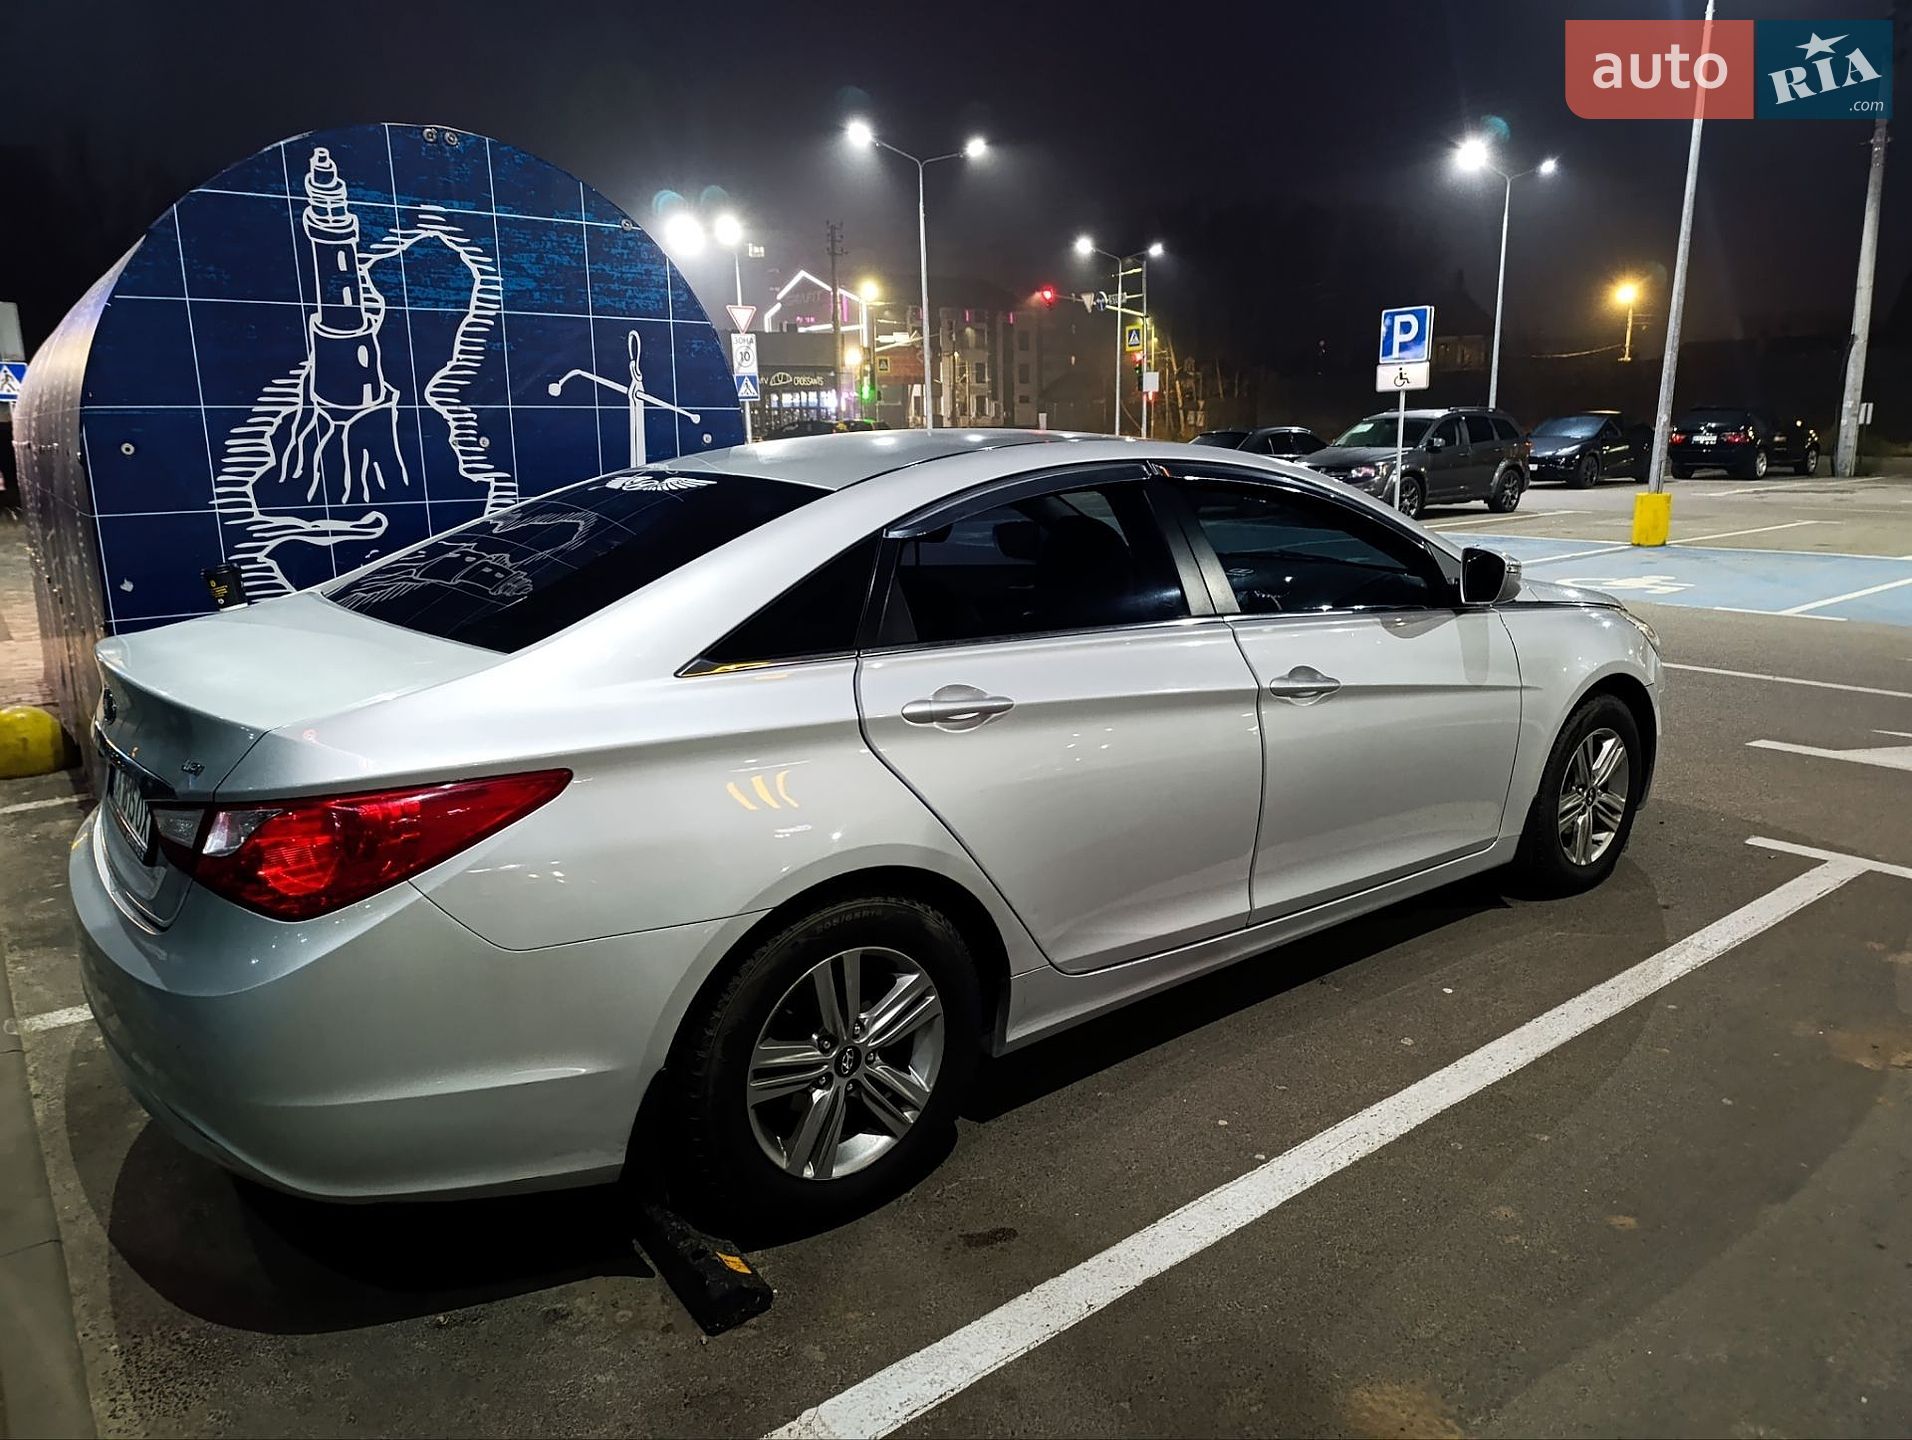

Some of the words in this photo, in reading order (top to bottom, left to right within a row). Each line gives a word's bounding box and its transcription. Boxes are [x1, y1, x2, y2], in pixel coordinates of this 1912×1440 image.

[733, 336, 754, 345] ЗОНА
[1392, 314, 1419, 359] P
[739, 351, 751, 363] 10
